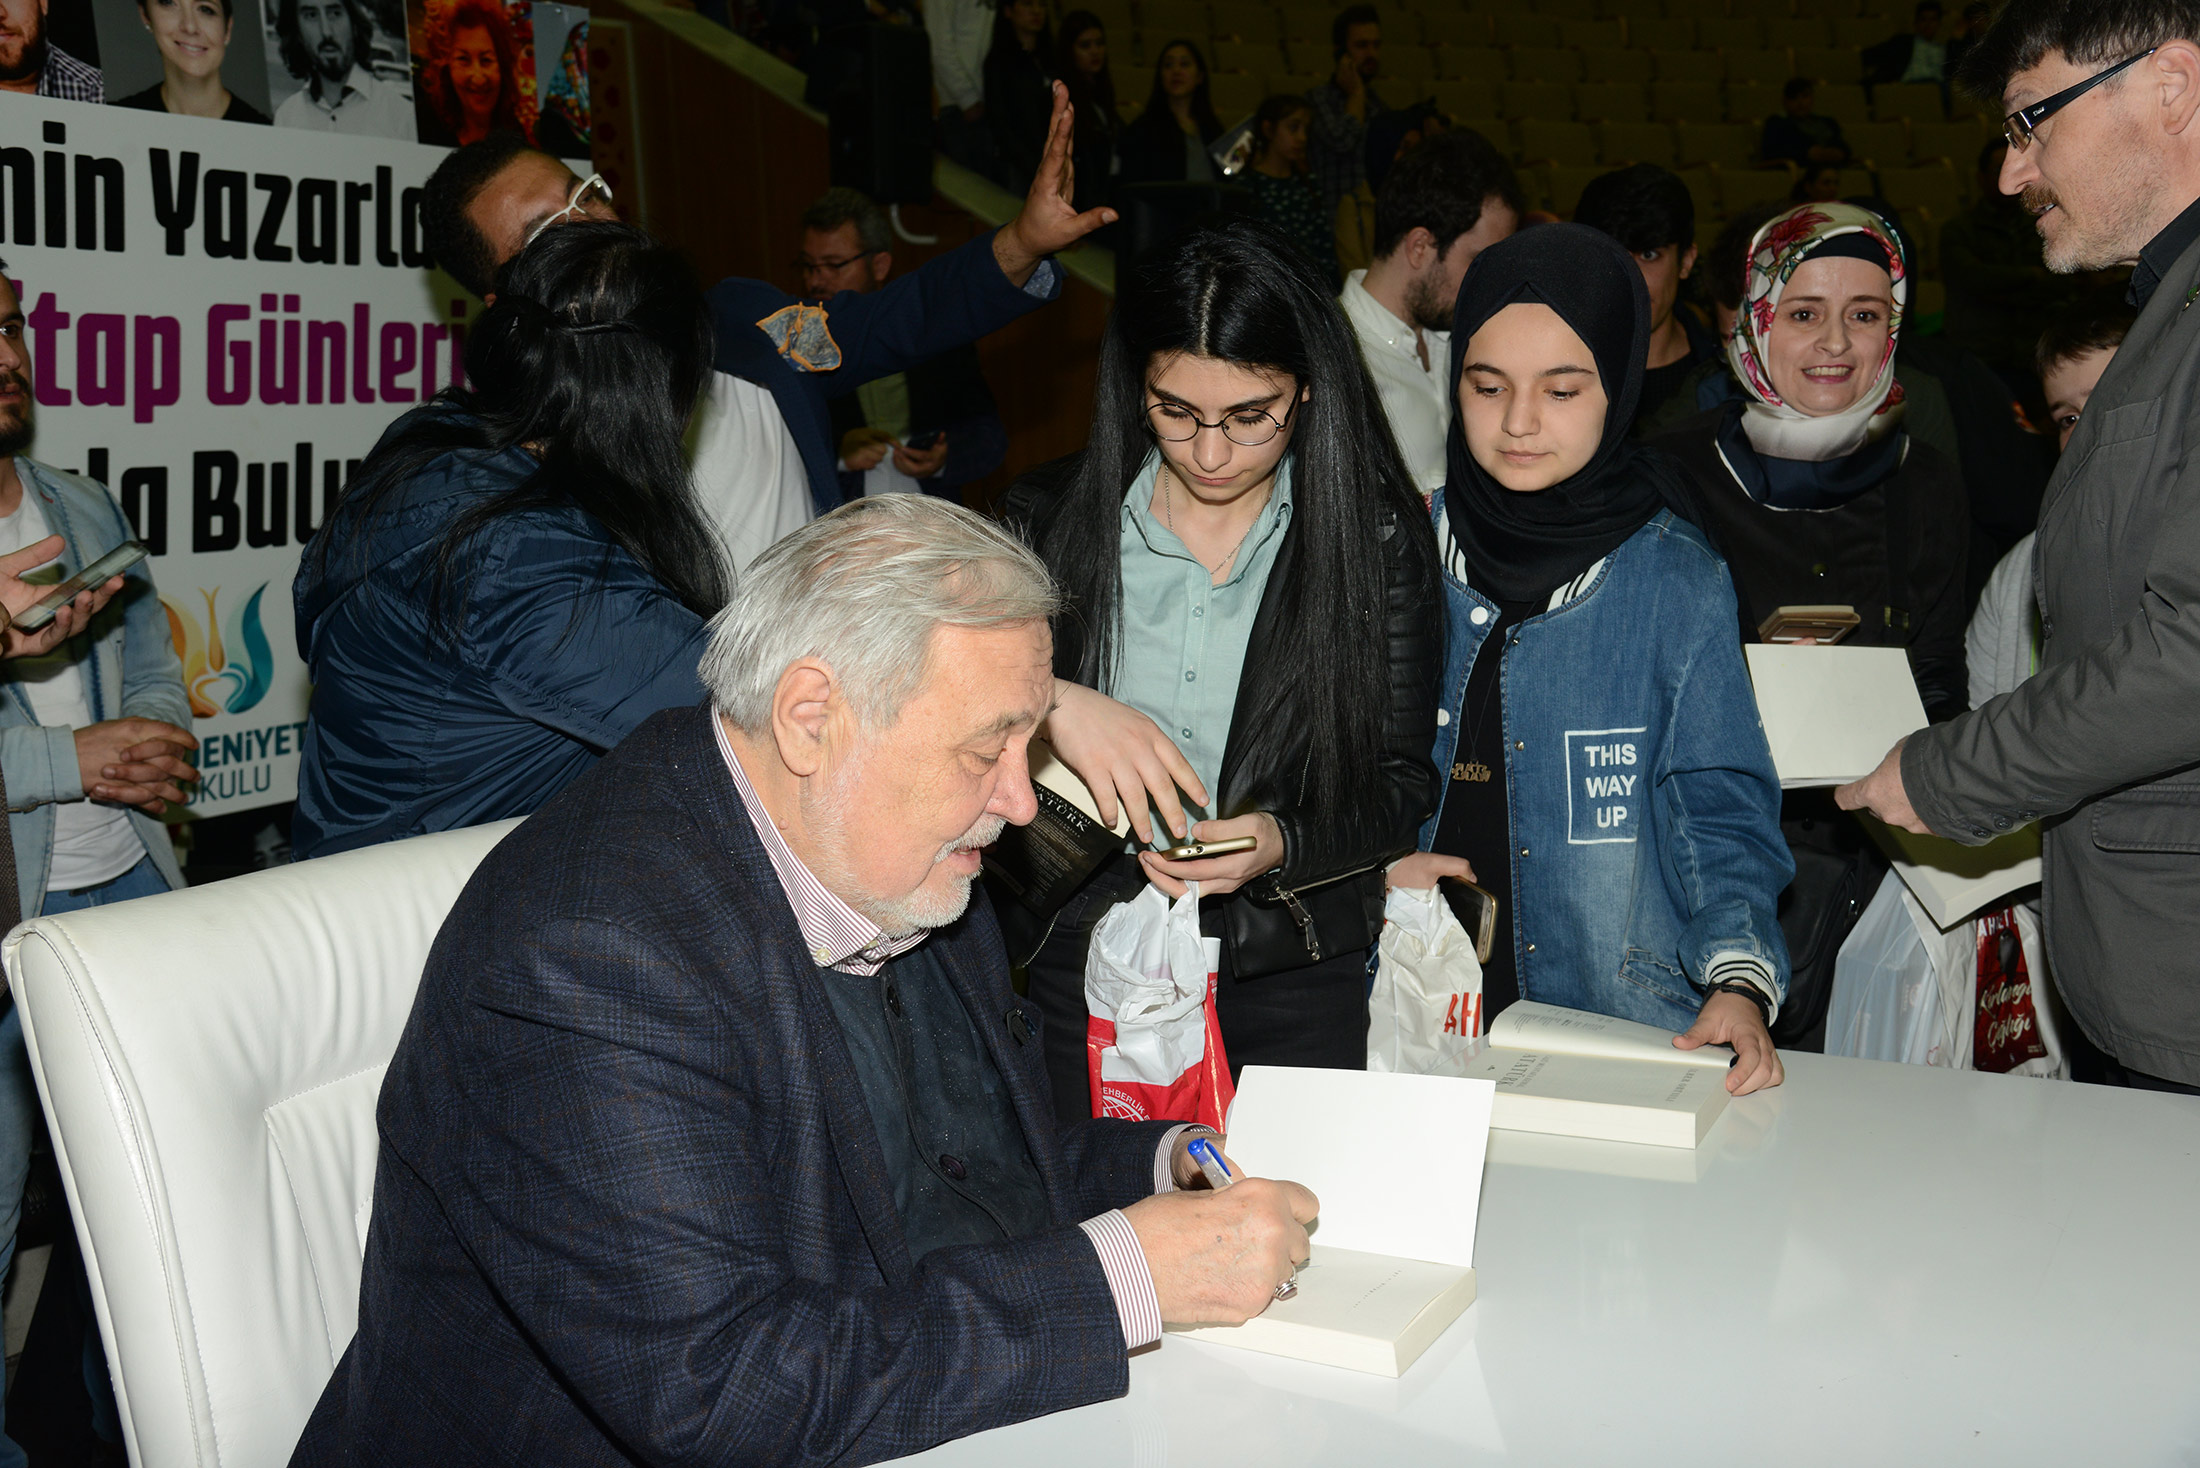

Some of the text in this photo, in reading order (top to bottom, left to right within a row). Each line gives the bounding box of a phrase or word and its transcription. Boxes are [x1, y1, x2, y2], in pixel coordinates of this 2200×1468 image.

[10, 279, 181, 423] tap
[1584, 743, 1637, 768] THIS
[1585, 774, 1638, 798] WAY
[1597, 806, 1627, 829] UP
